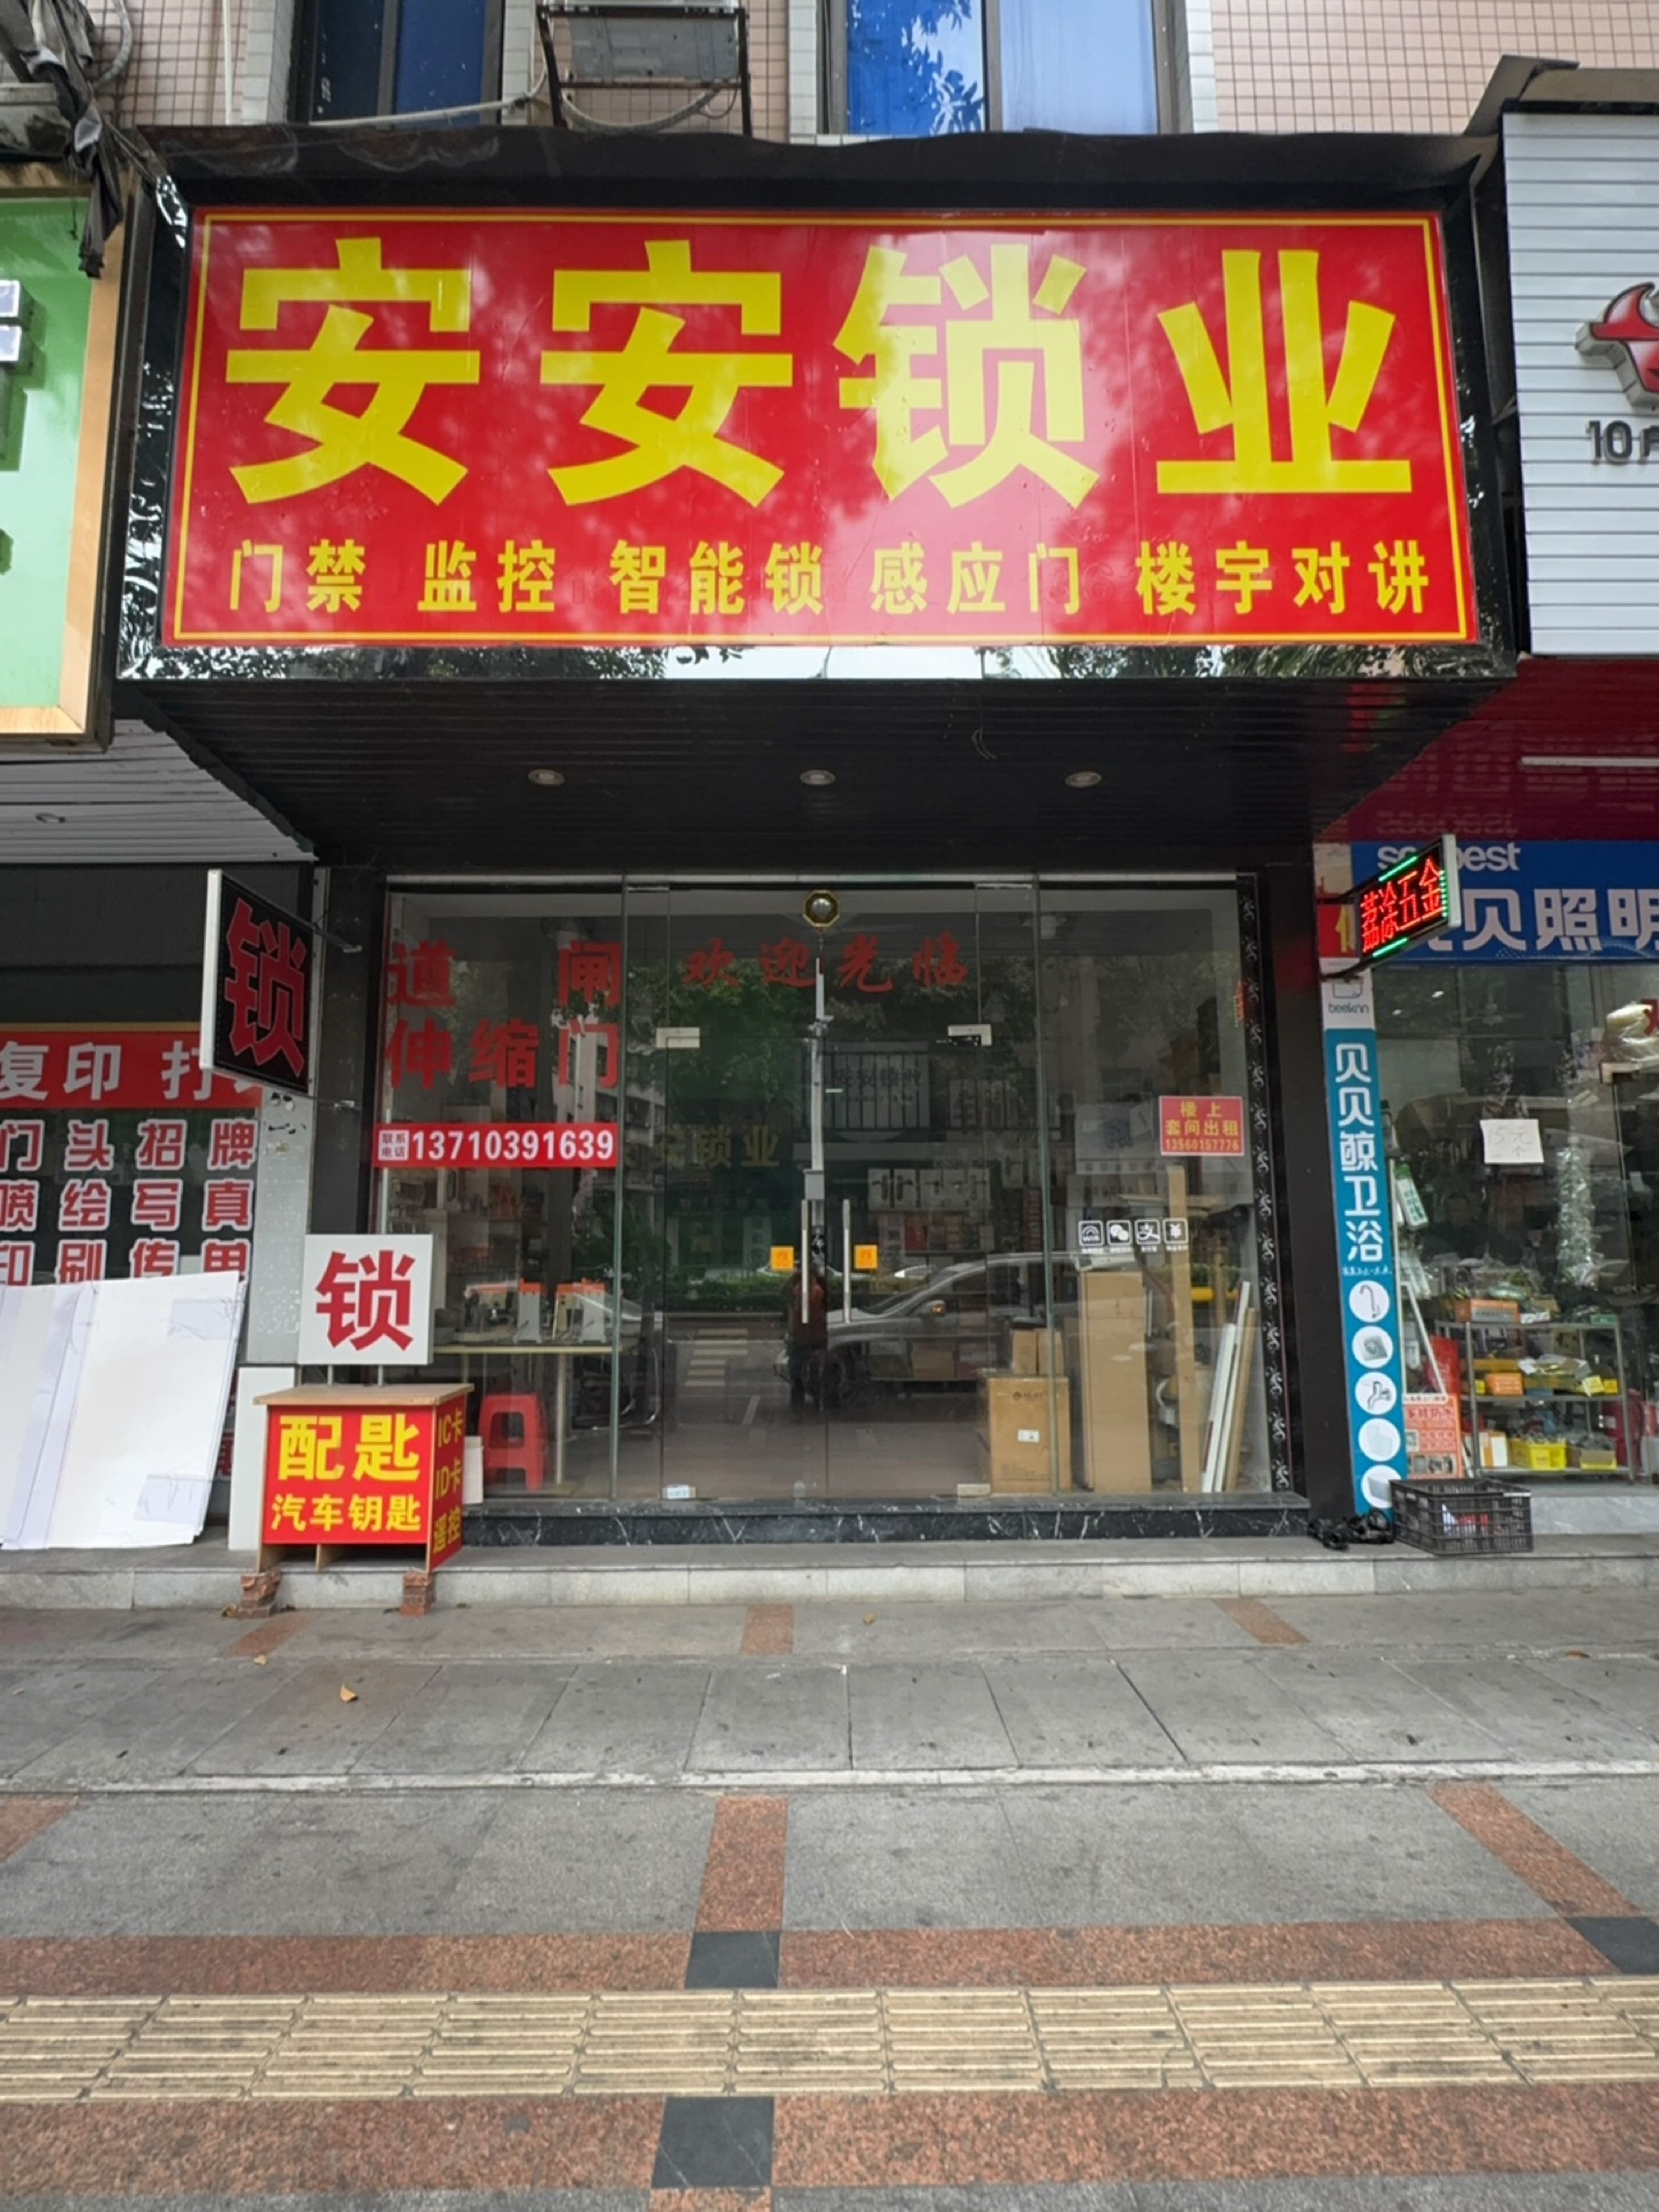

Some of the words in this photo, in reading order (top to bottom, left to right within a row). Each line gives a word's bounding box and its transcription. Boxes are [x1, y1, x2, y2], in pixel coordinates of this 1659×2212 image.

[226, 236, 1412, 509] 安安锁业
[230, 538, 365, 613] 门禁
[417, 538, 556, 613] 监控
[609, 540, 822, 615] 智能锁
[870, 540, 1080, 616] 感应门
[1135, 540, 1429, 616] 楼宇对讲
[1429, 888, 1659, 951] 贝照明
[225, 897, 308, 1077] 锁
[384, 939, 621, 1007] 道闸
[681, 932, 967, 993] 欢迎光临
[0, 1040, 122, 1101] 复印
[384, 1018, 619, 1089] 伸缩门
[1166, 1119, 1238, 1136] 套间出租
[1180, 1101, 1222, 1118] 楼上
[0, 1120, 256, 1170] 门头招牌
[412, 1130, 614, 1160] 13710391639
[1334, 1043, 1385, 1263] 贝贝鲸卫浴
[316, 1250, 415, 1350] 锁
[276, 1413, 420, 1482] 配匙
[437, 1407, 463, 1448] IC卡
[435, 1456, 461, 1500] ID卡
[271, 1494, 421, 1532] 汽车钥匙
